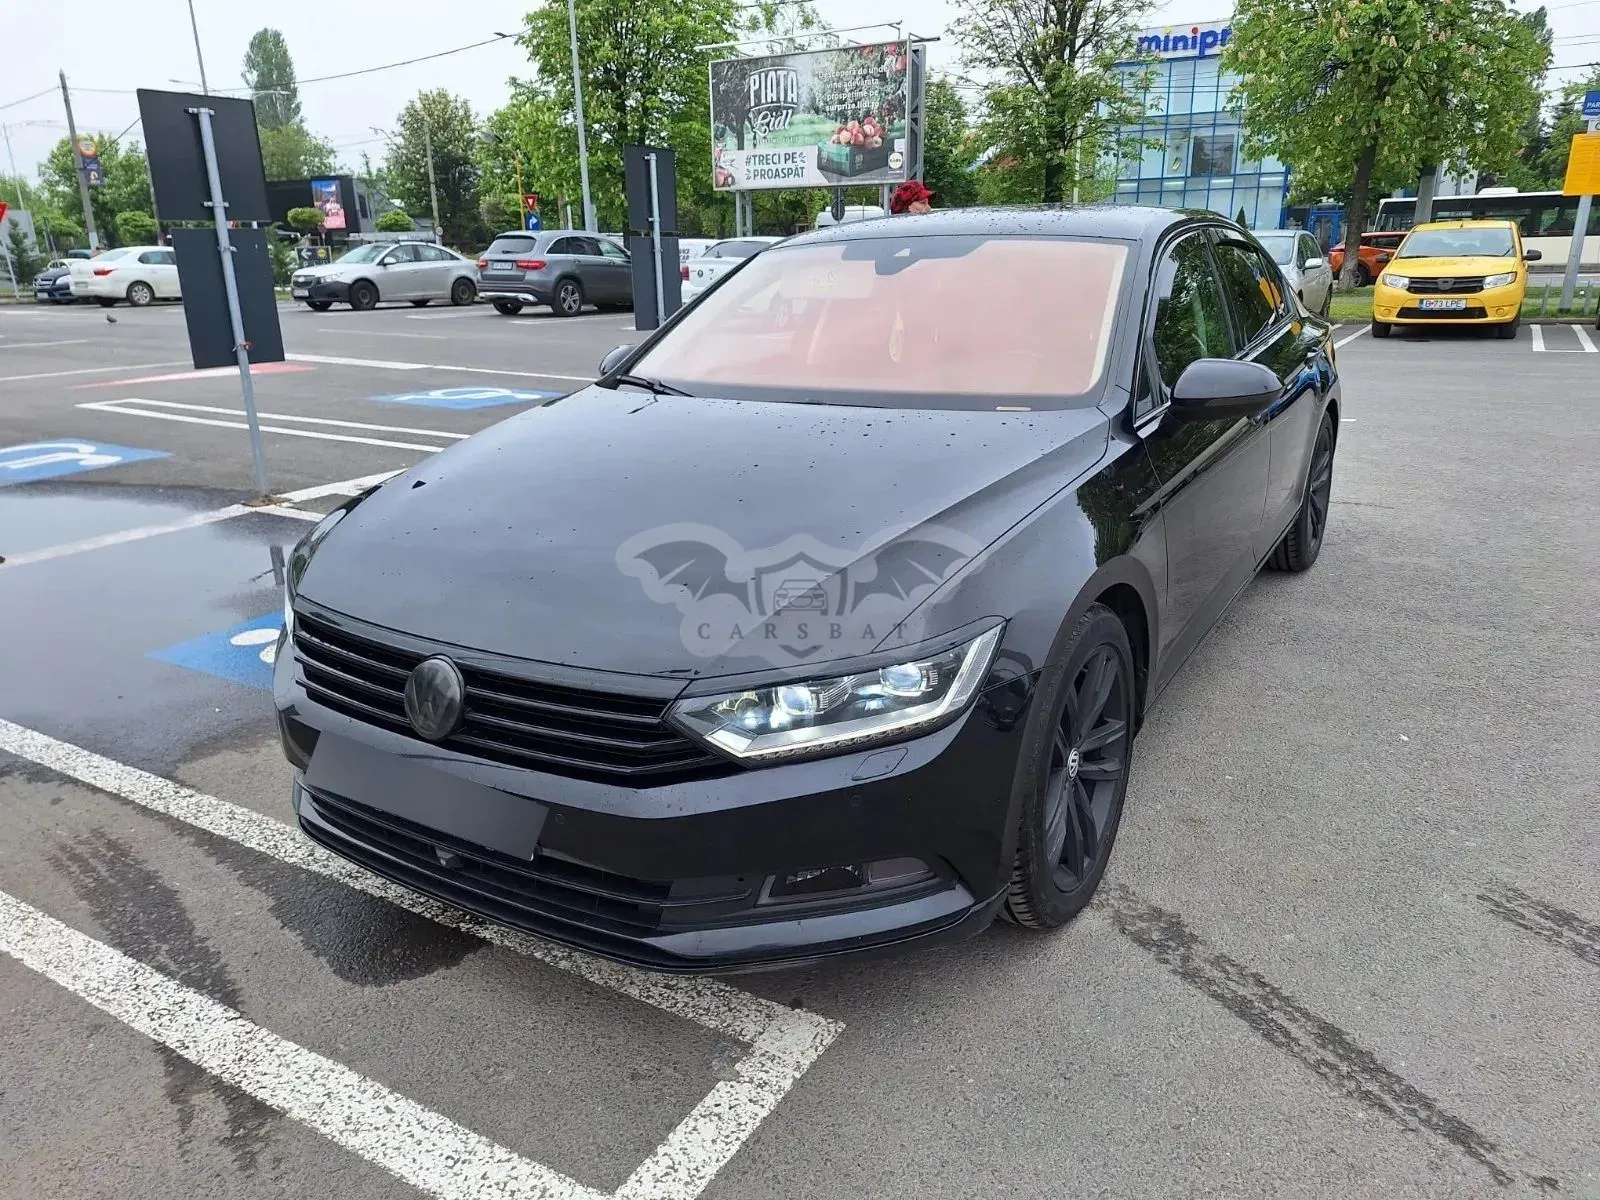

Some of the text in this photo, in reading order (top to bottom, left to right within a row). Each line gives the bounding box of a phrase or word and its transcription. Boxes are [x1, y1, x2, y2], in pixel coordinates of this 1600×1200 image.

[745, 151, 797, 166] #TRECI PE
[753, 164, 805, 180] PROASPĂT
